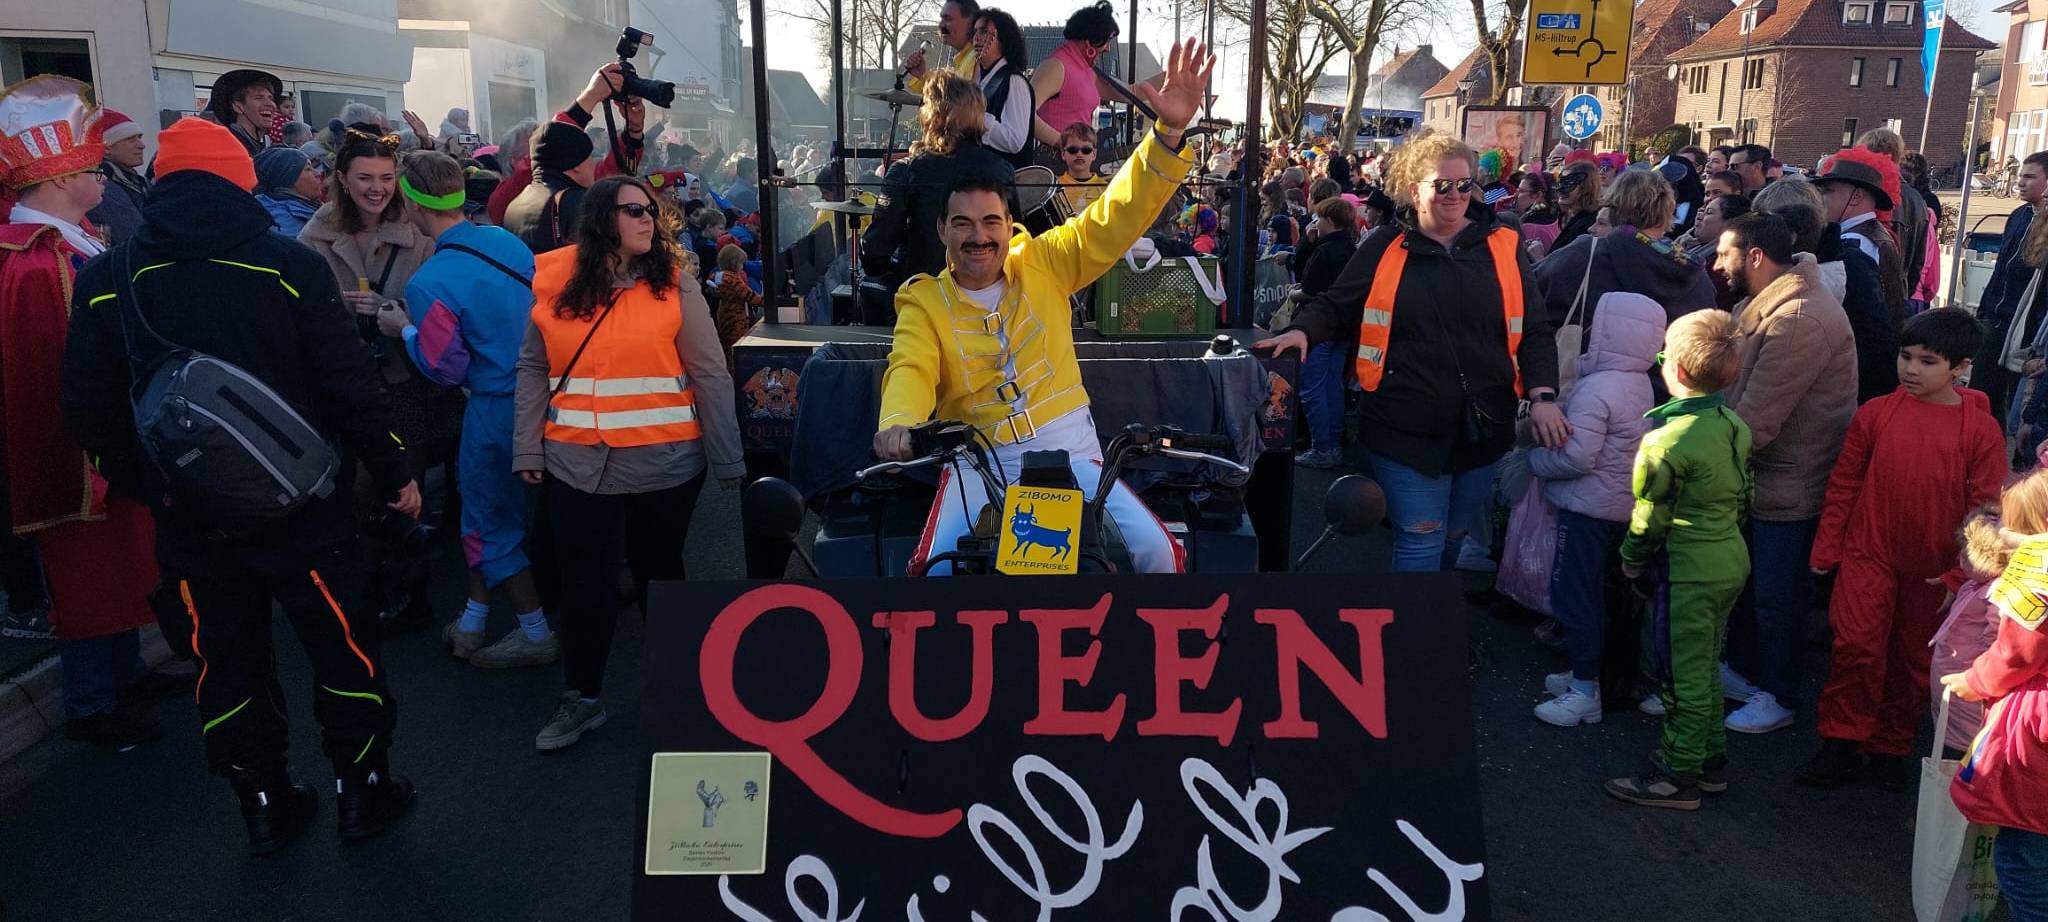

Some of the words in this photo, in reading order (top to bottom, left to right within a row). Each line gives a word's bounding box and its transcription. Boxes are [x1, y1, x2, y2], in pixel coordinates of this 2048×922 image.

[1535, 32, 1577, 45] MS-Hiltrup
[747, 424, 793, 441] QUEE
[1018, 491, 1072, 503] ZIBOMO
[1004, 560, 1071, 571] ENTERPRISES
[699, 583, 1395, 838] QUEEN
